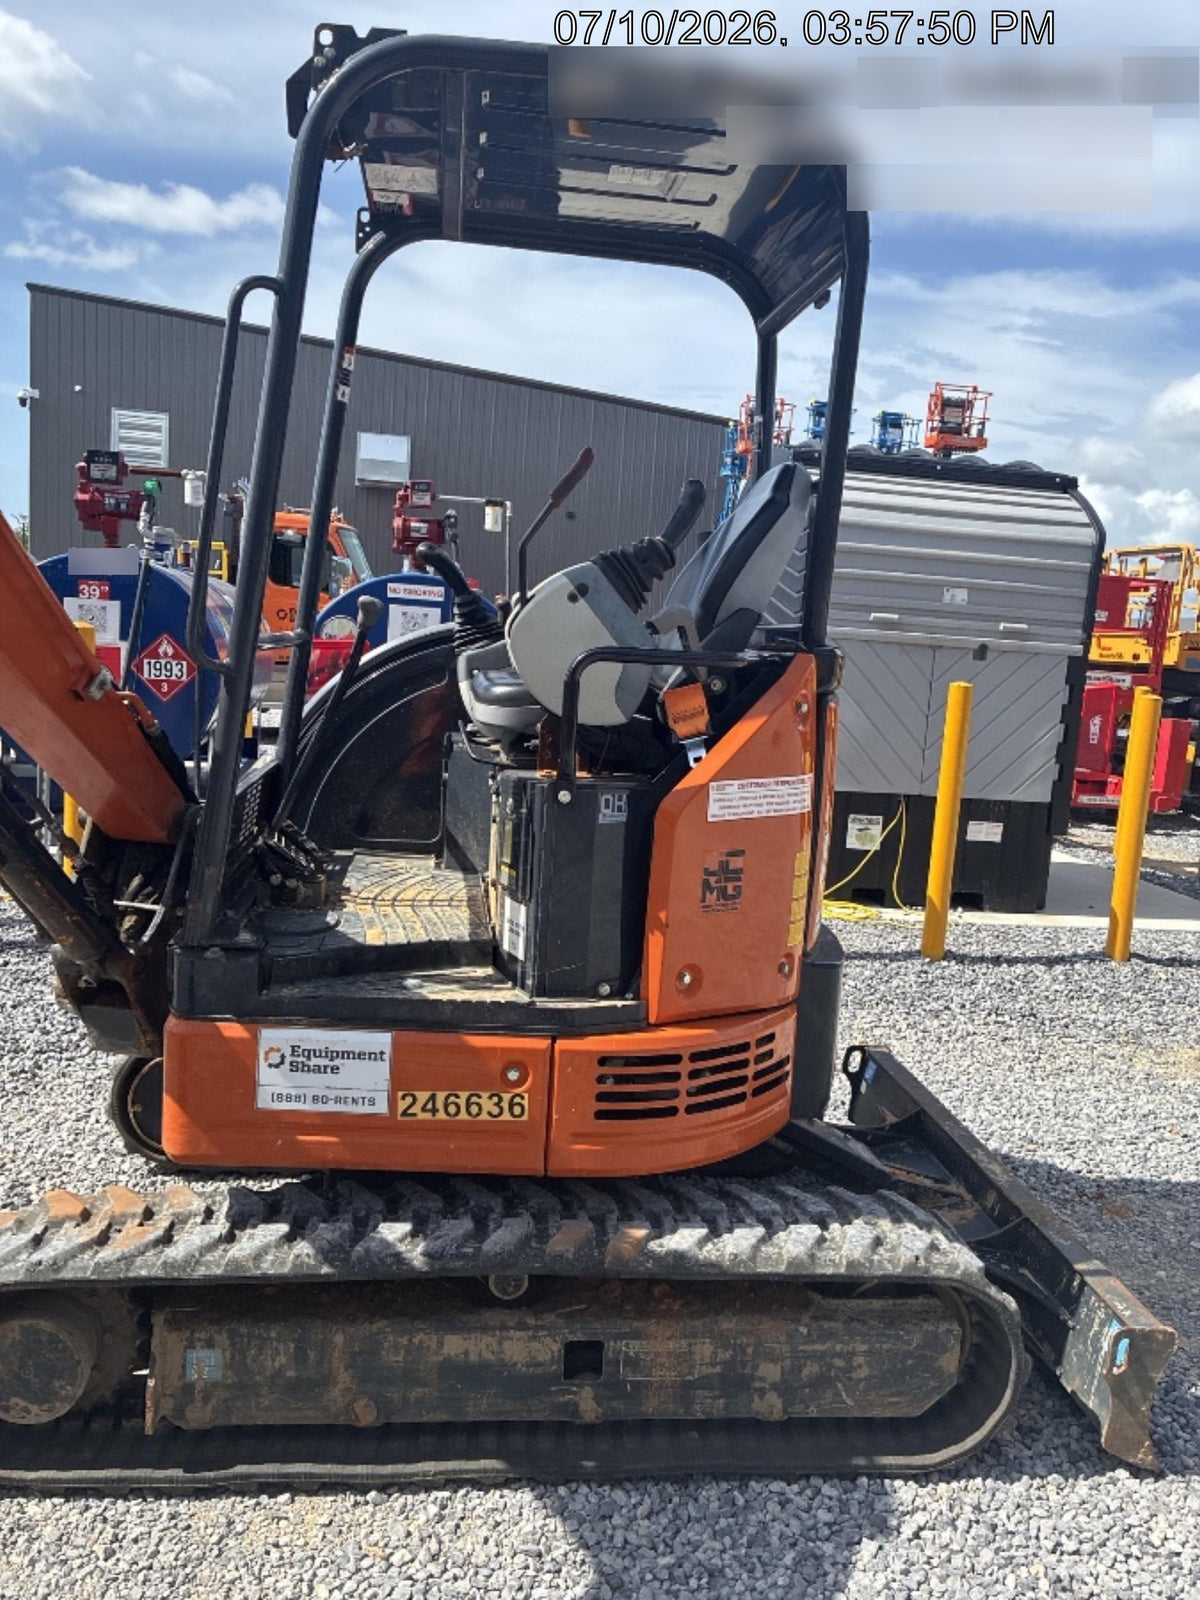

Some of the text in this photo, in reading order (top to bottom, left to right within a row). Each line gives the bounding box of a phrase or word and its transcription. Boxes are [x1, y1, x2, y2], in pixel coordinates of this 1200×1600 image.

[146, 660, 184, 679] 1993
[160, 682, 168, 693] 3
[289, 1045, 386, 1062] Equipment
[288, 1060, 341, 1075] Share
[271, 1092, 377, 1107] (888) 80-RENTS
[399, 1092, 526, 1119] 246636
